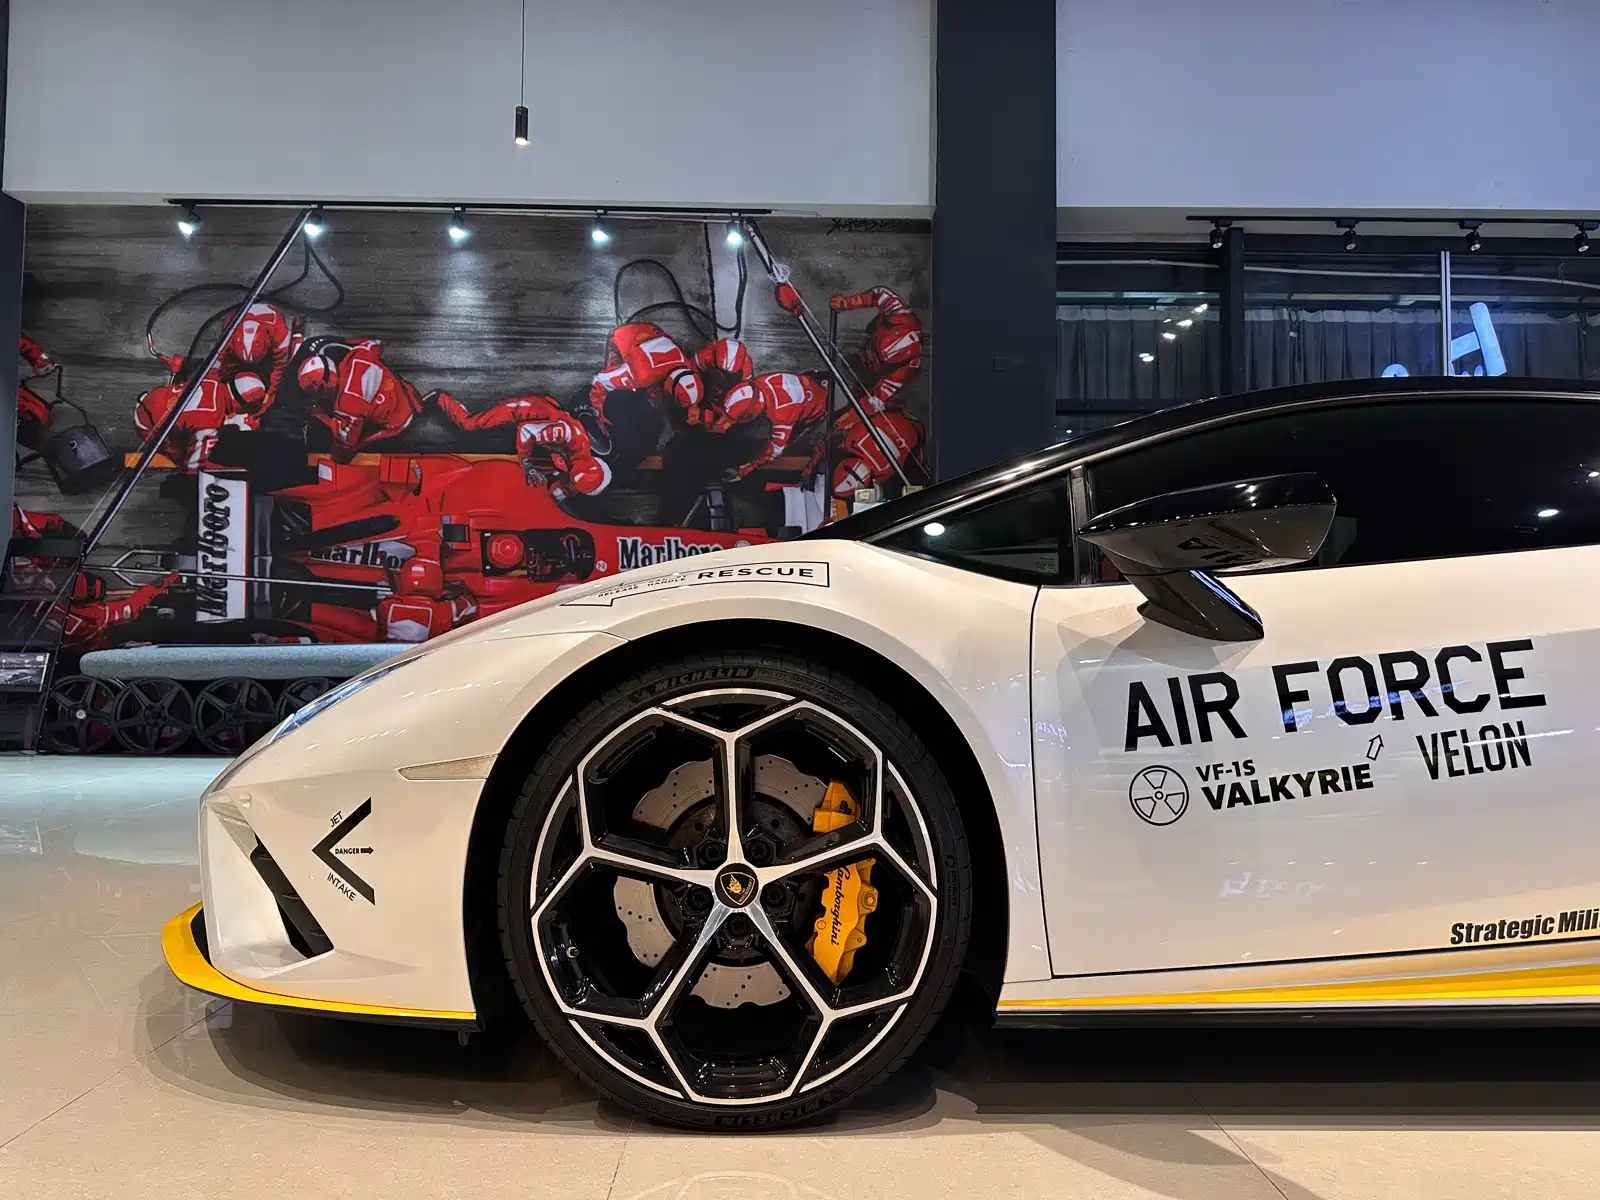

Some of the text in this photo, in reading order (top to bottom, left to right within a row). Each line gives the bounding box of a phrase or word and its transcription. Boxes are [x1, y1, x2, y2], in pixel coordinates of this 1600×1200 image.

[619, 537, 722, 570] Marlb
[697, 567, 814, 580] RESCUE
[655, 668, 749, 691] MICHELIN
[1125, 638, 1547, 752] AIR FORCE
[1415, 720, 1532, 780] VELON
[1195, 759, 1256, 782] VF-1S
[1201, 763, 1374, 811] VALKYRIE
[329, 810, 343, 828] JET
[335, 847, 360, 855] DANGER
[327, 872, 357, 902] INTAKE
[831, 866, 850, 946] Lamborghini
[1450, 908, 1600, 945] Strategic Mili
